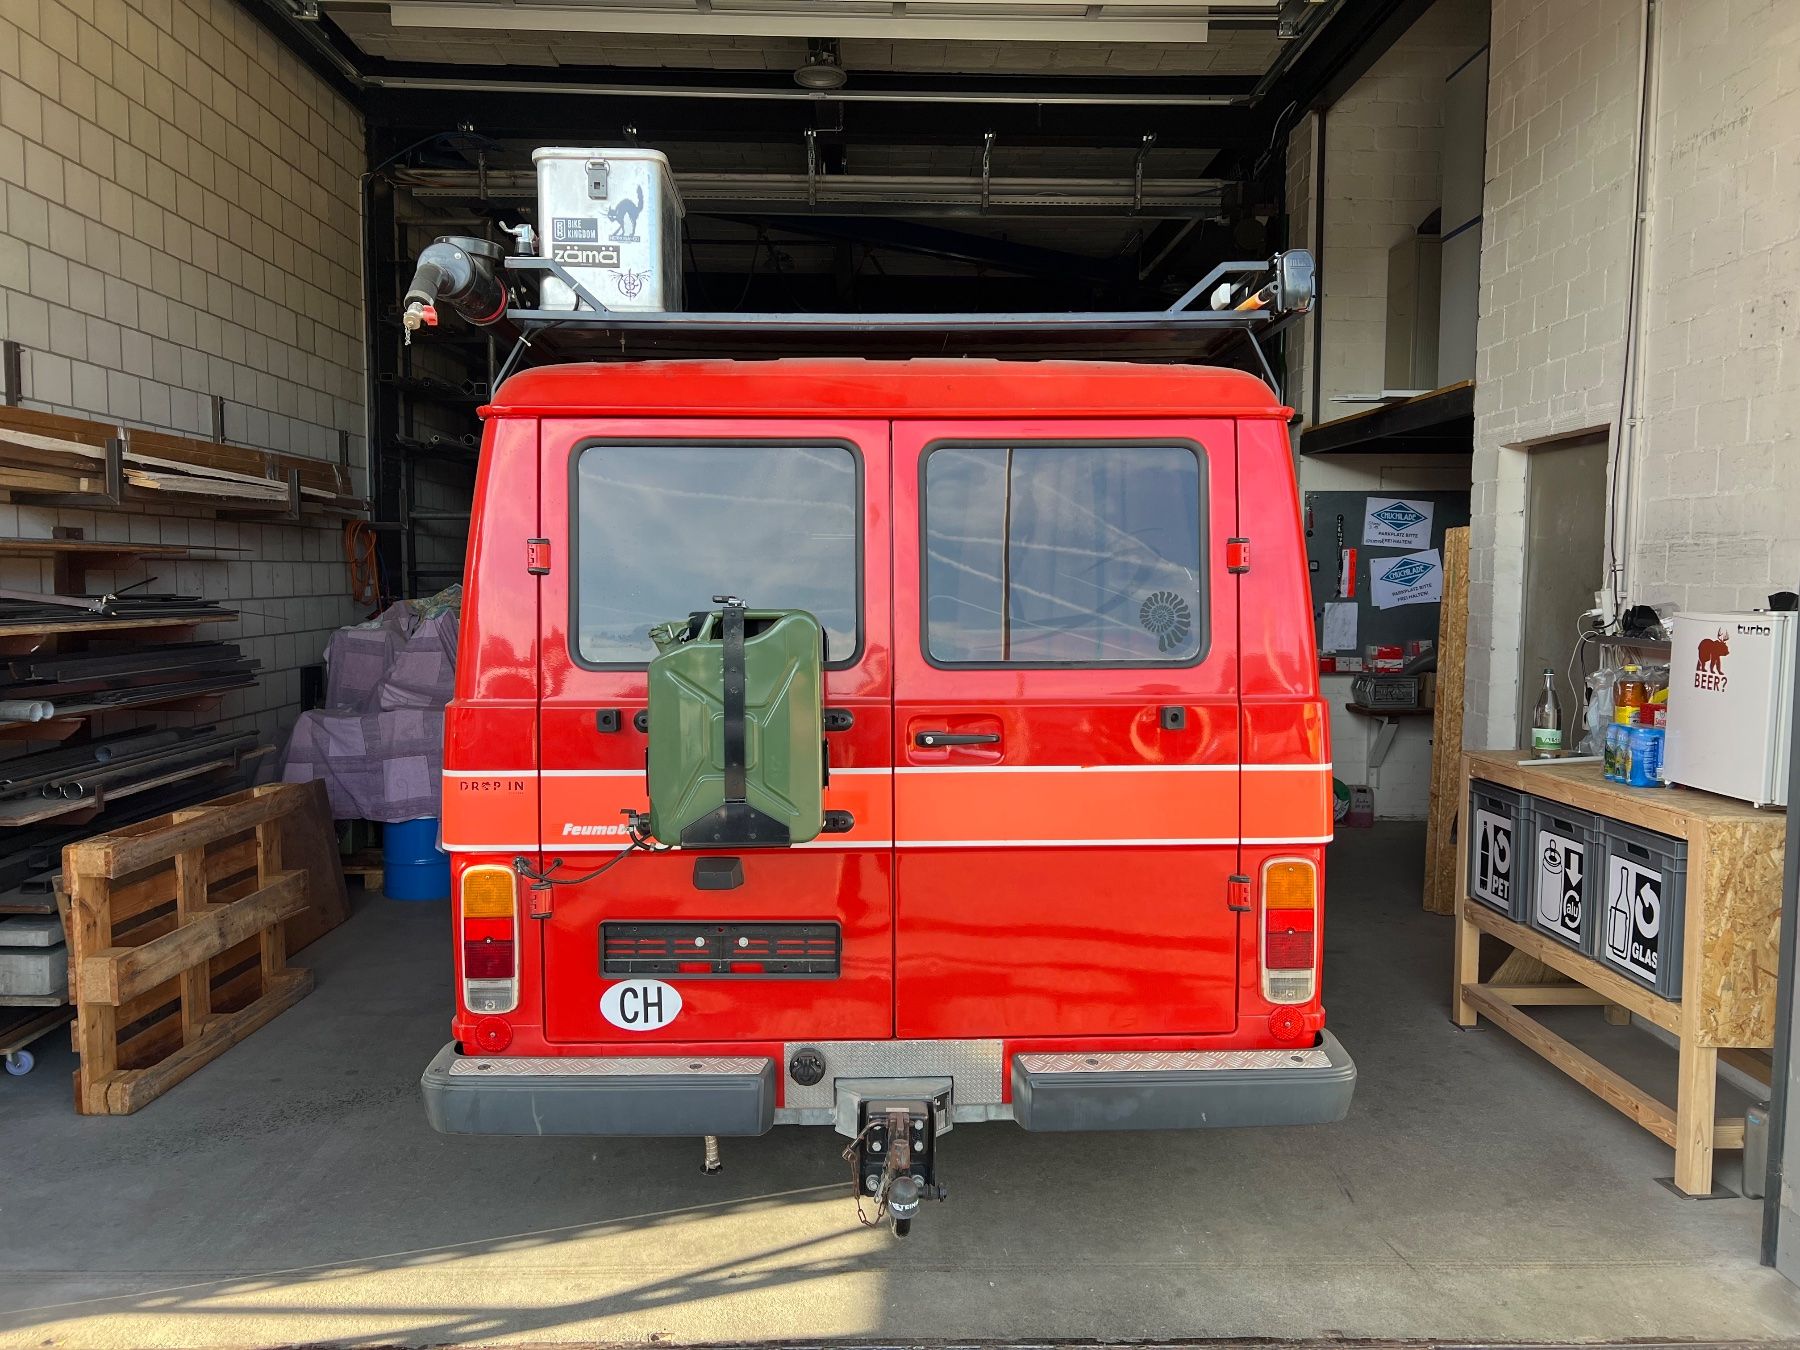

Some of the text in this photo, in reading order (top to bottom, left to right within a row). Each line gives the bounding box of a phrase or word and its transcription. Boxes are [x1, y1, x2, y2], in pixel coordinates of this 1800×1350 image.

[567, 219, 582, 229] BIKE
[567, 229, 596, 239] KINGDOM
[554, 246, 617, 263] zämä
[1737, 624, 1771, 636] turbo
[1694, 672, 1728, 693] BEER?
[508, 781, 524, 791] IN
[1492, 876, 1509, 899] PET
[1566, 900, 1579, 918] alu
[1631, 942, 1657, 969] GLAS
[619, 987, 664, 1024] CH
